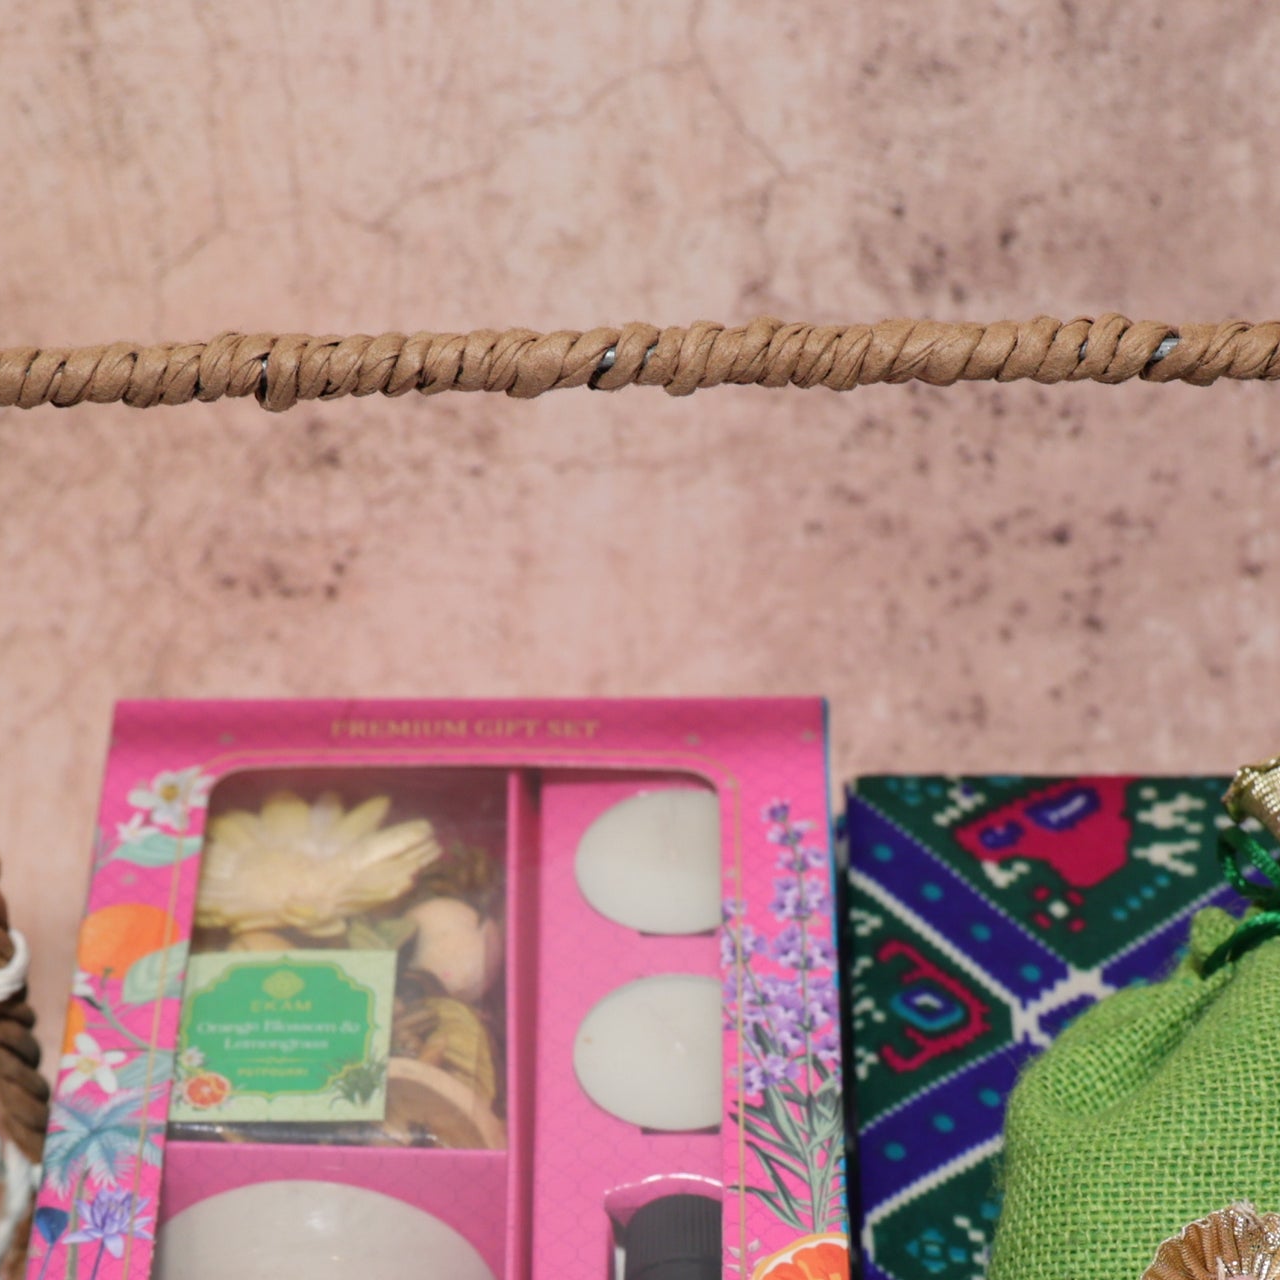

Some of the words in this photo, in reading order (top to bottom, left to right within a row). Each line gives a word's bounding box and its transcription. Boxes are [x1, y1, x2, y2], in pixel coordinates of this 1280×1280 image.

[330, 718, 467, 738] PREMIUM
[474, 718, 539, 738] GIFT
[546, 718, 601, 738] SET
